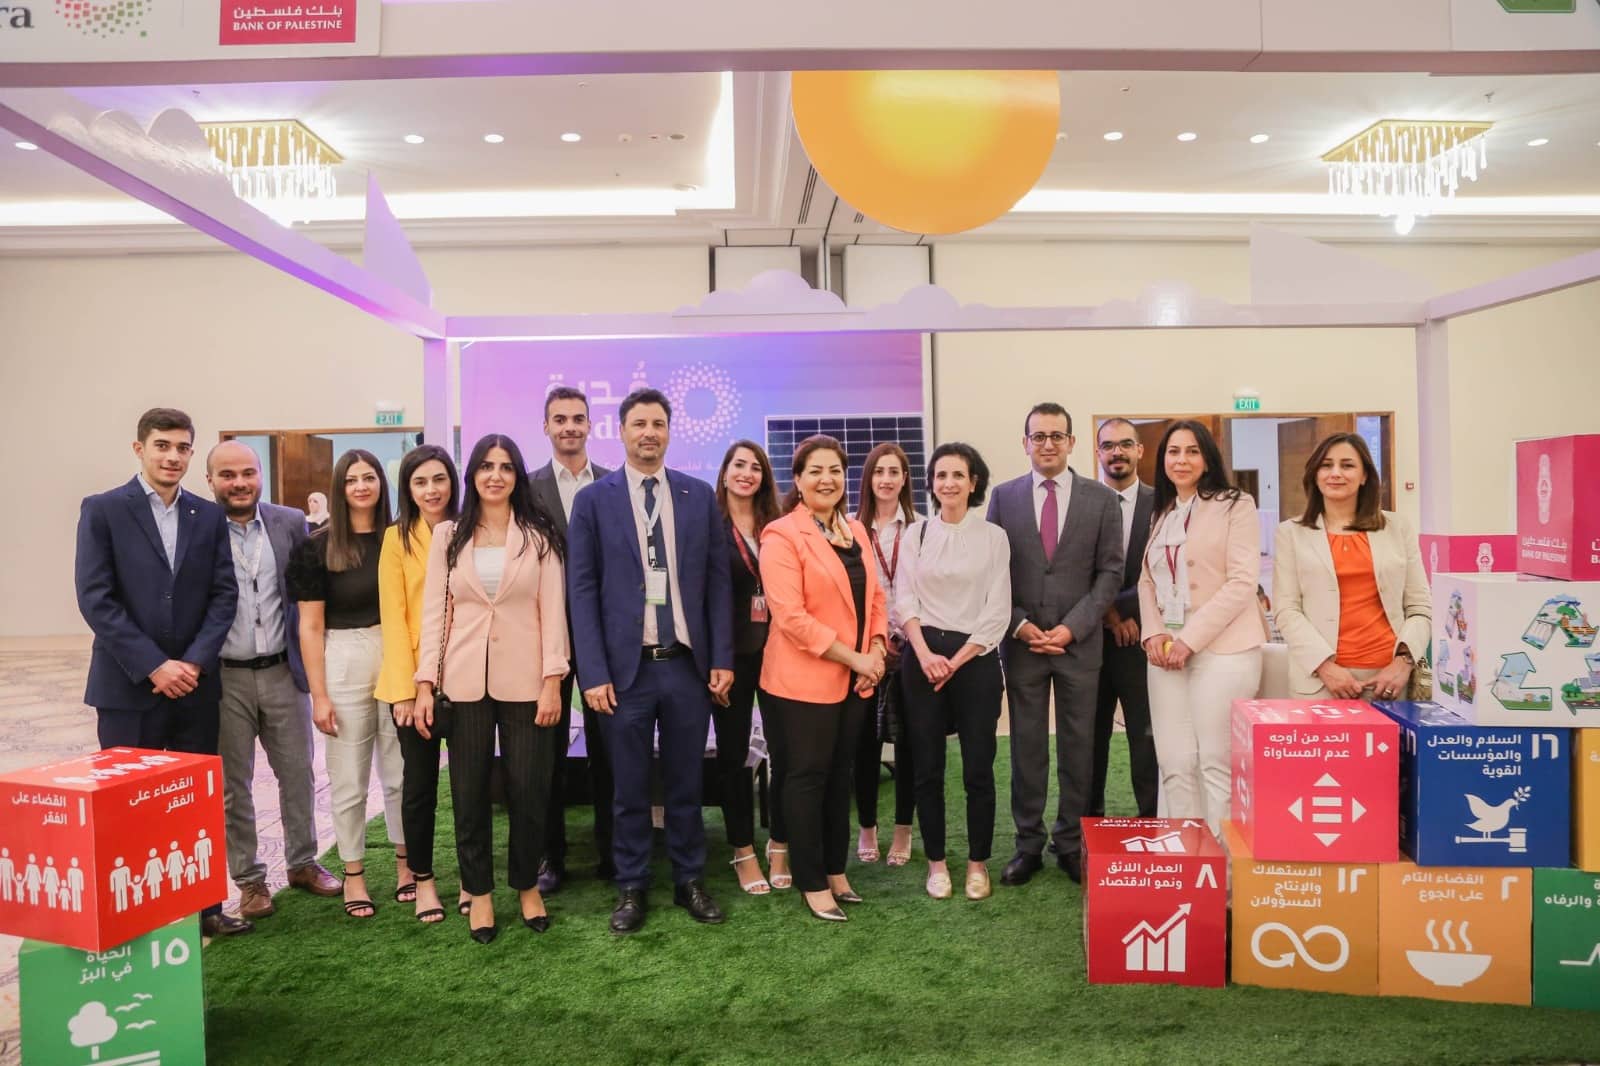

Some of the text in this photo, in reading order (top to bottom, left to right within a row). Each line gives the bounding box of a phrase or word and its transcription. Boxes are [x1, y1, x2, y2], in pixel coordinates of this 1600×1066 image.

[233, 5, 343, 19] بنك فلسطين
[233, 19, 343, 31] BANK OF PALESTINE
[1239, 399, 1257, 409] EXIT
[1269, 730, 1350, 745] الحد من أوجه
[1427, 734, 1522, 748] السلام والعدل
[1263, 747, 1350, 761] عدم المساواة
[1438, 748, 1522, 762] والمؤسسات
[1482, 764, 1522, 778] القوية
[129, 776, 194, 807] القضاء على
[12, 792, 67, 808] القضاء على
[165, 793, 195, 813] الفقر
[42, 811, 67, 826] الفقر
[1107, 861, 1182, 875] العمل اللائق
[1252, 864, 1322, 877] الاستهلاك
[1098, 876, 1183, 890] ونمو الاقتصاد
[1436, 873, 1484, 885] القضاء
[1274, 881, 1322, 896] والإنتاج
[1250, 895, 1321, 908] المسؤولان
[1418, 889, 1484, 903] على الجوع
[1544, 895, 1592, 908] والرفاه
[112, 962, 133, 982] في
